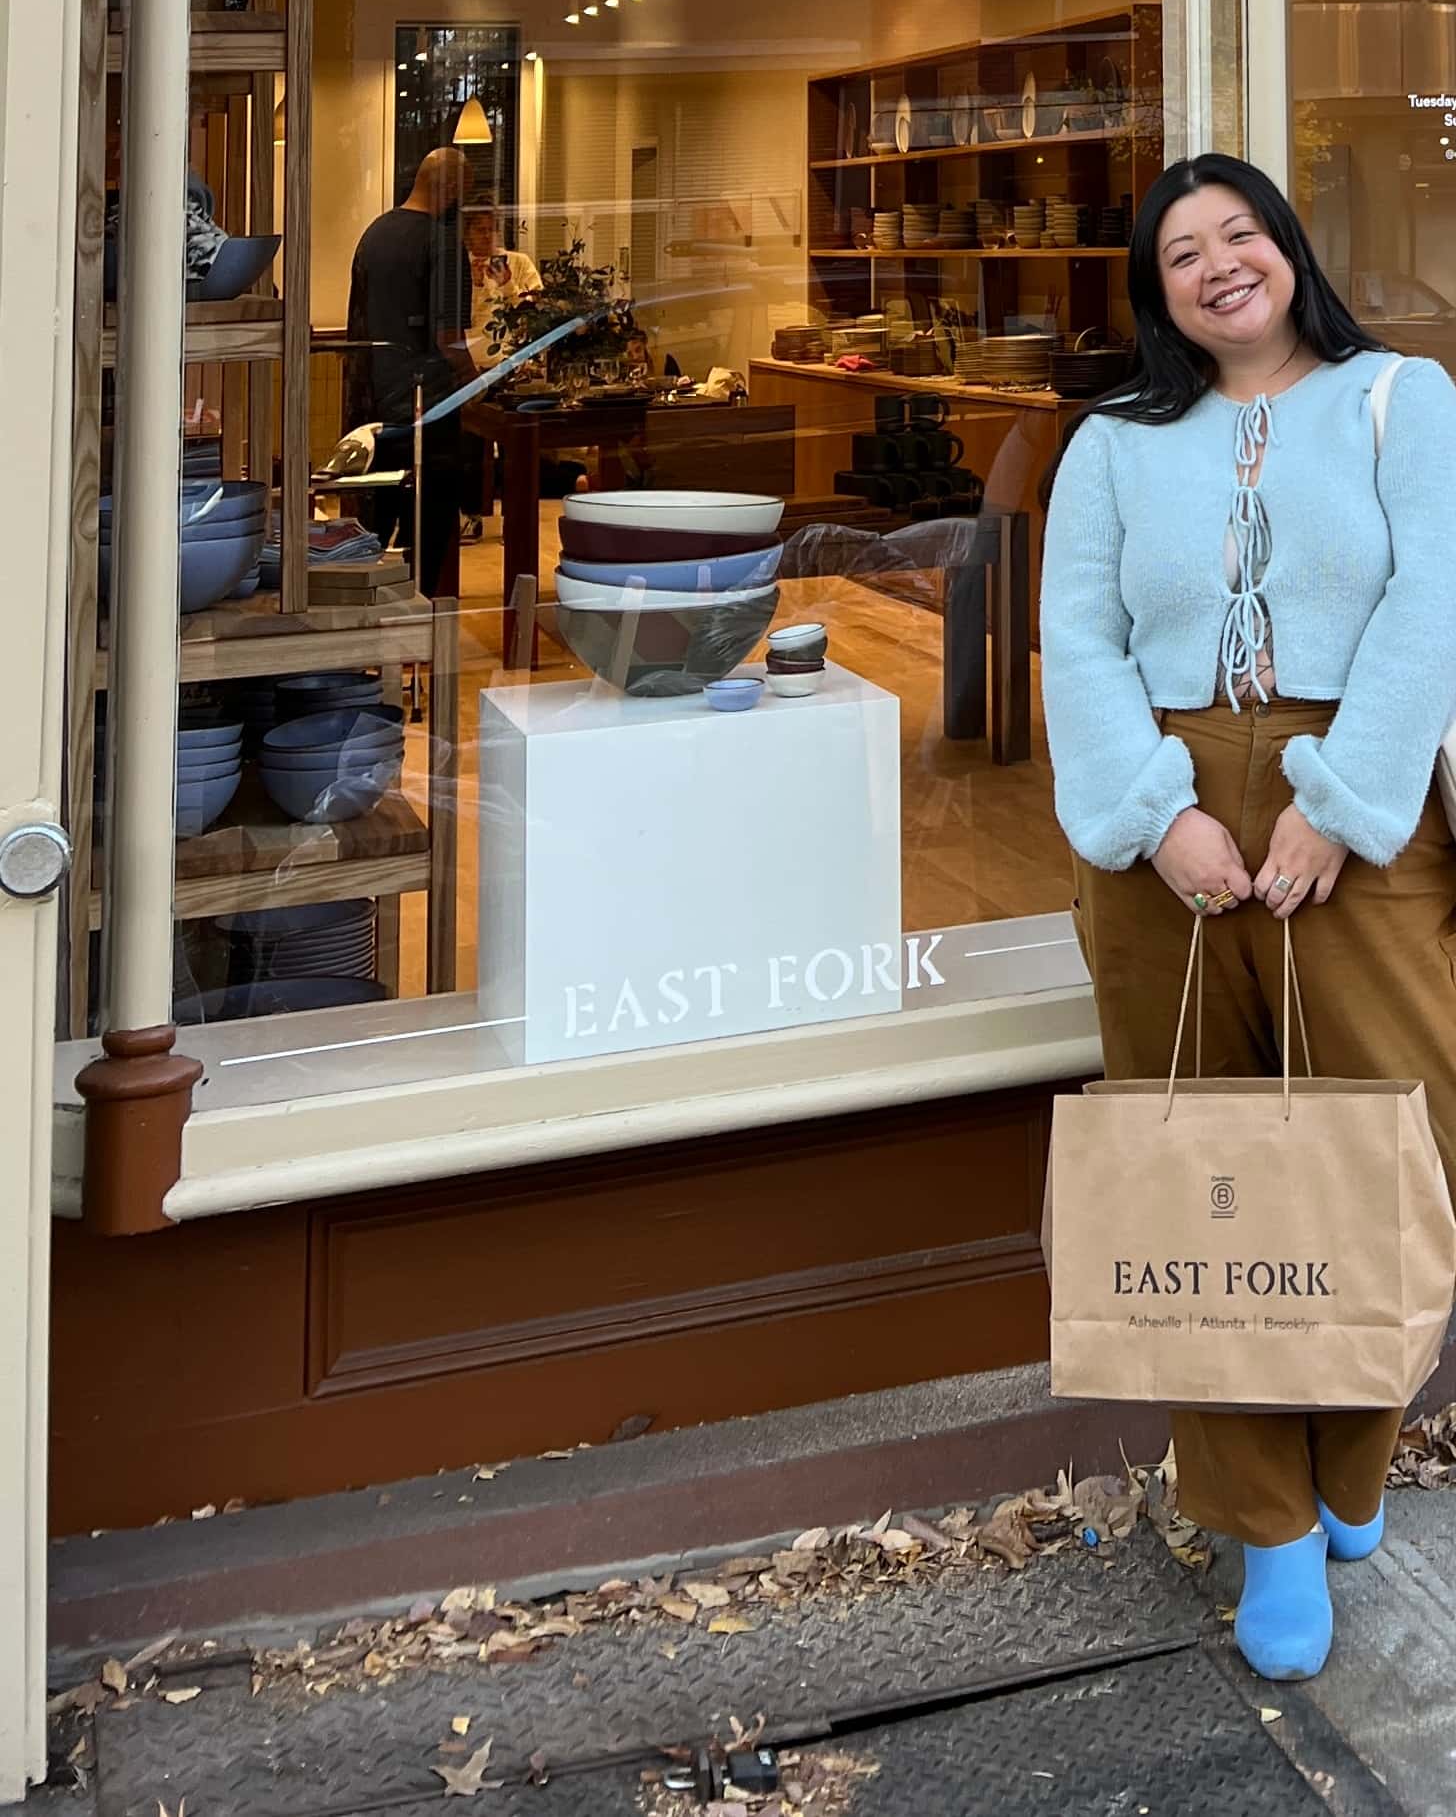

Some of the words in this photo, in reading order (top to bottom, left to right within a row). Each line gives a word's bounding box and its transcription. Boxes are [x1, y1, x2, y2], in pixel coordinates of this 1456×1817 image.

[564, 962, 738, 1038] EAST
[767, 934, 946, 1009] FORK
[1113, 1261, 1209, 1295] EAST
[1225, 1261, 1331, 1296] FORK
[1128, 1314, 1182, 1329] Asheville
[1200, 1315, 1246, 1330] Atlanta
[1264, 1316, 1319, 1332] Brooklyn
